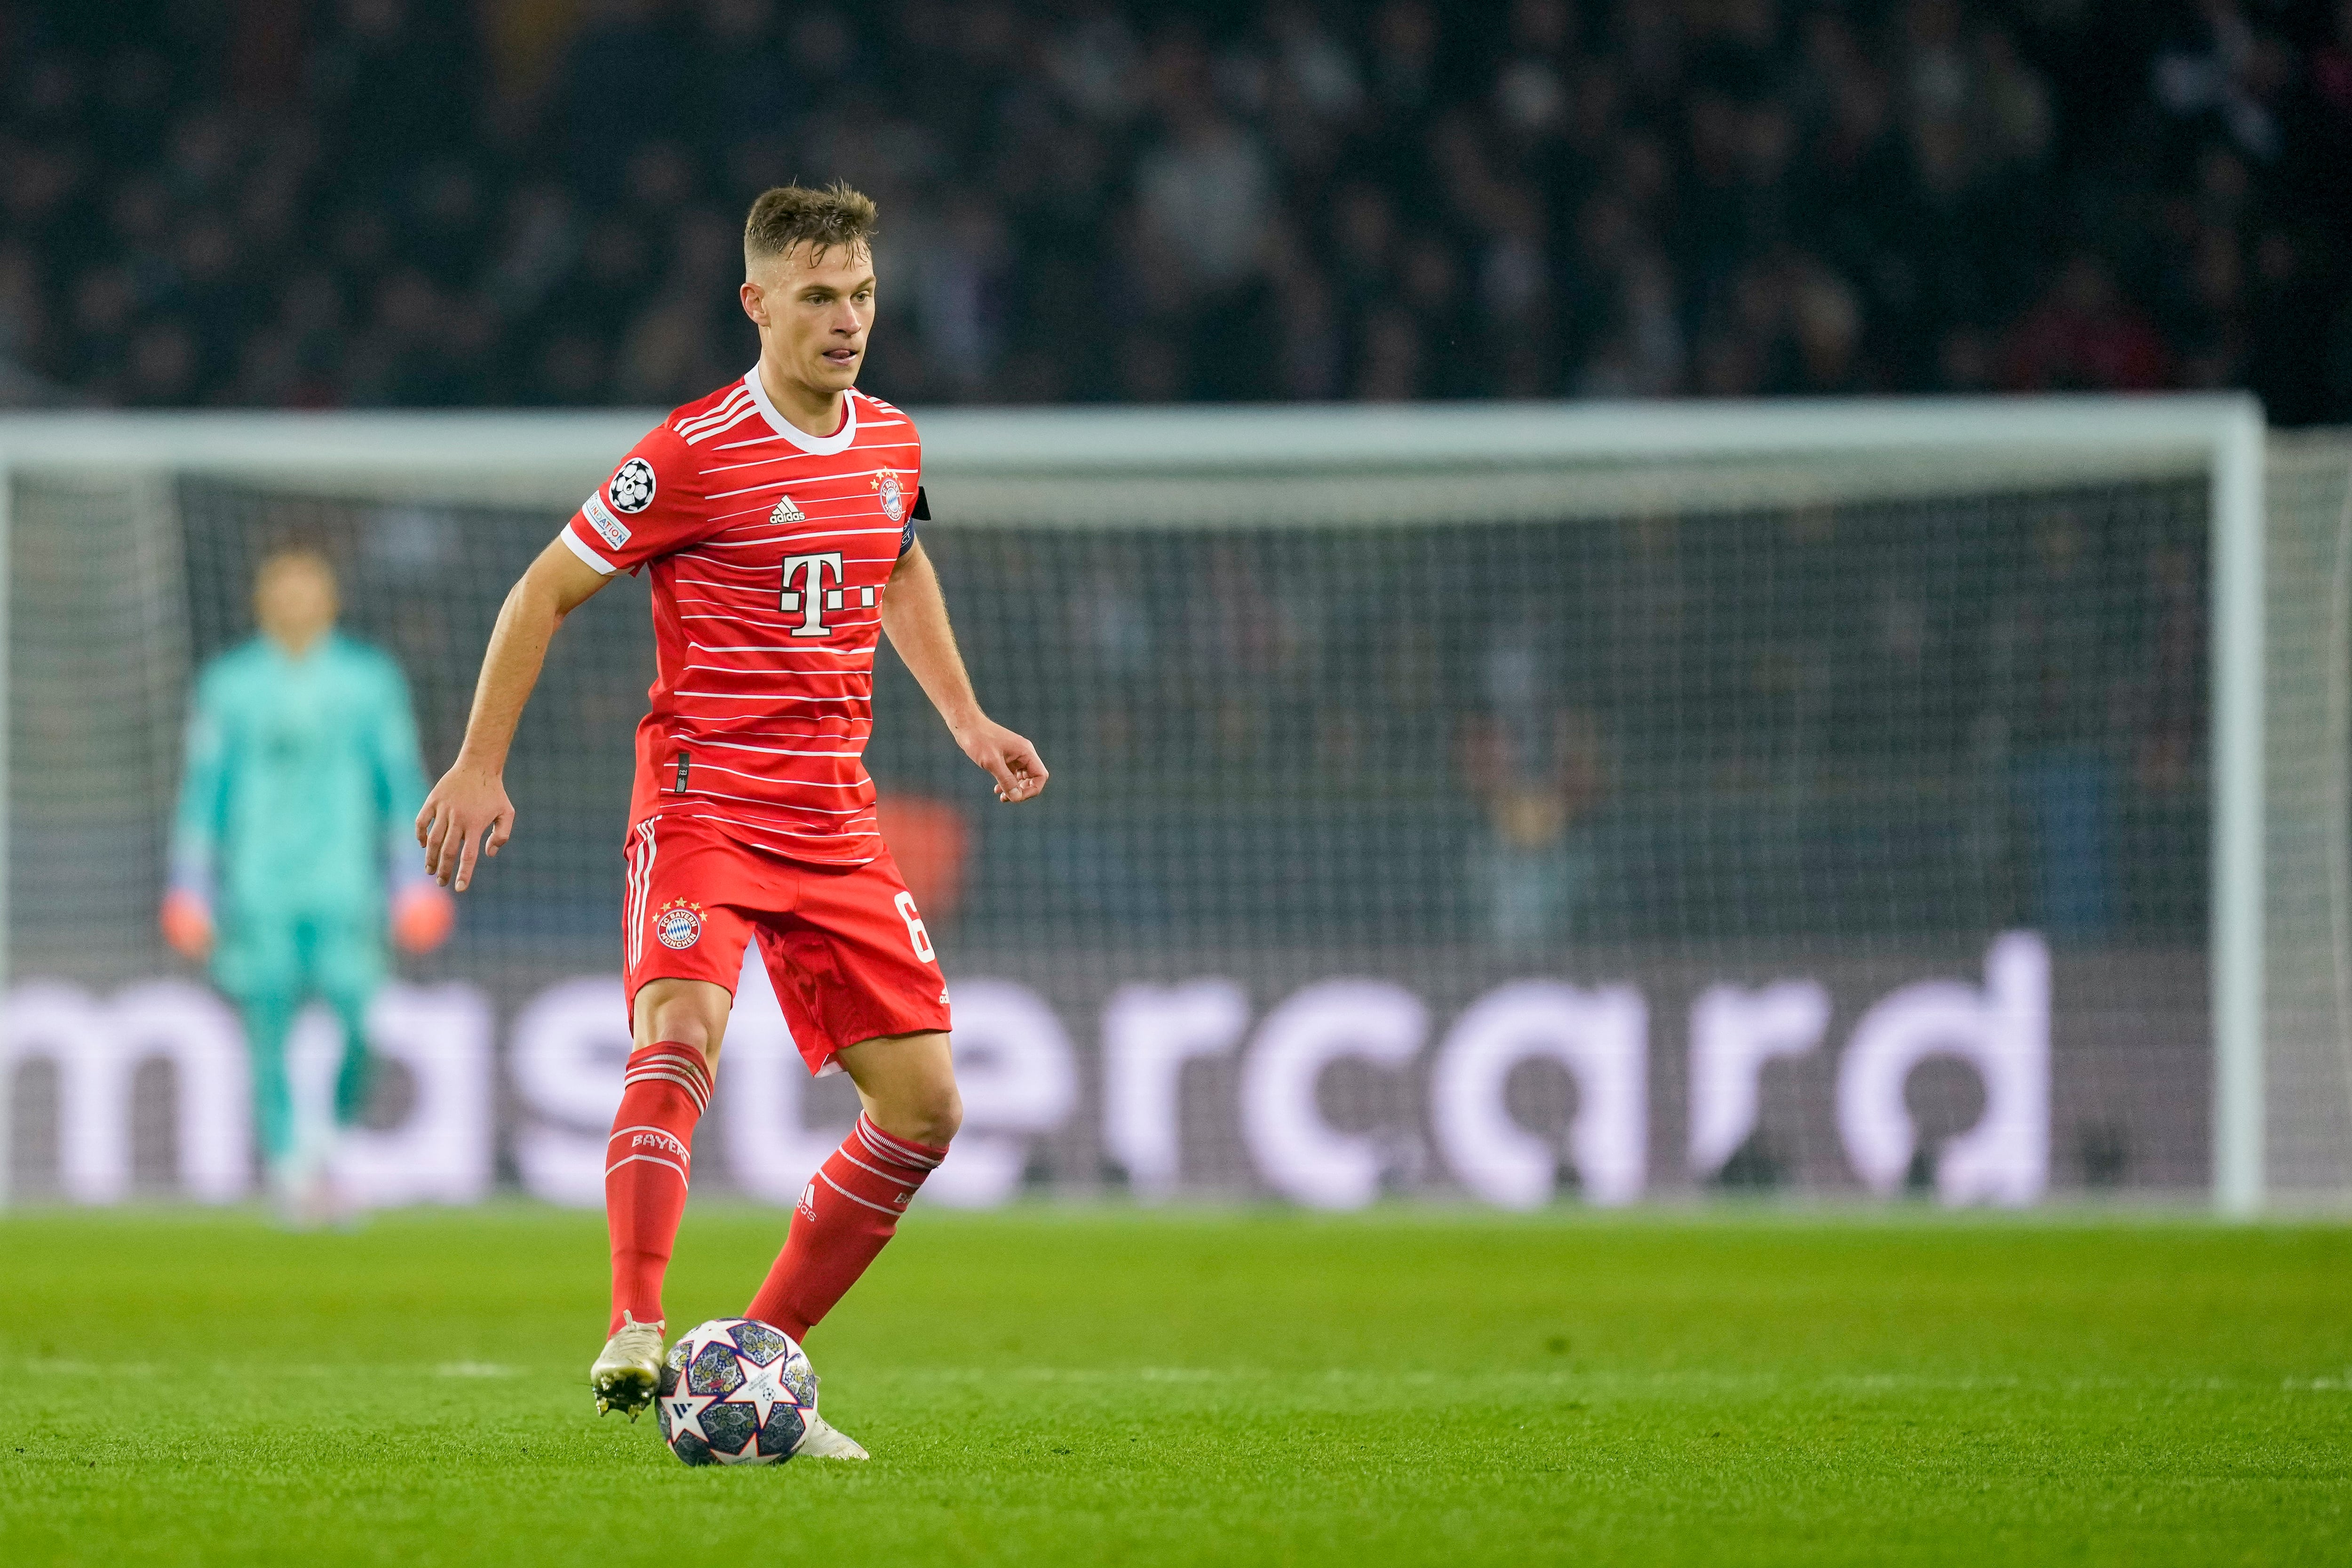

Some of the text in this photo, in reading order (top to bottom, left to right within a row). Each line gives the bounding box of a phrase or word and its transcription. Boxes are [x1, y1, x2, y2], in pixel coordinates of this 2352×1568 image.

[623, 475, 637, 495] 6
[588, 496, 625, 543] UNDATION
[770, 511, 805, 524] adidas
[661, 912, 697, 927] FC BAYERN
[894, 891, 935, 963] 6
[0, 929, 2052, 1205] mastercard
[797, 1196, 817, 1222] das
